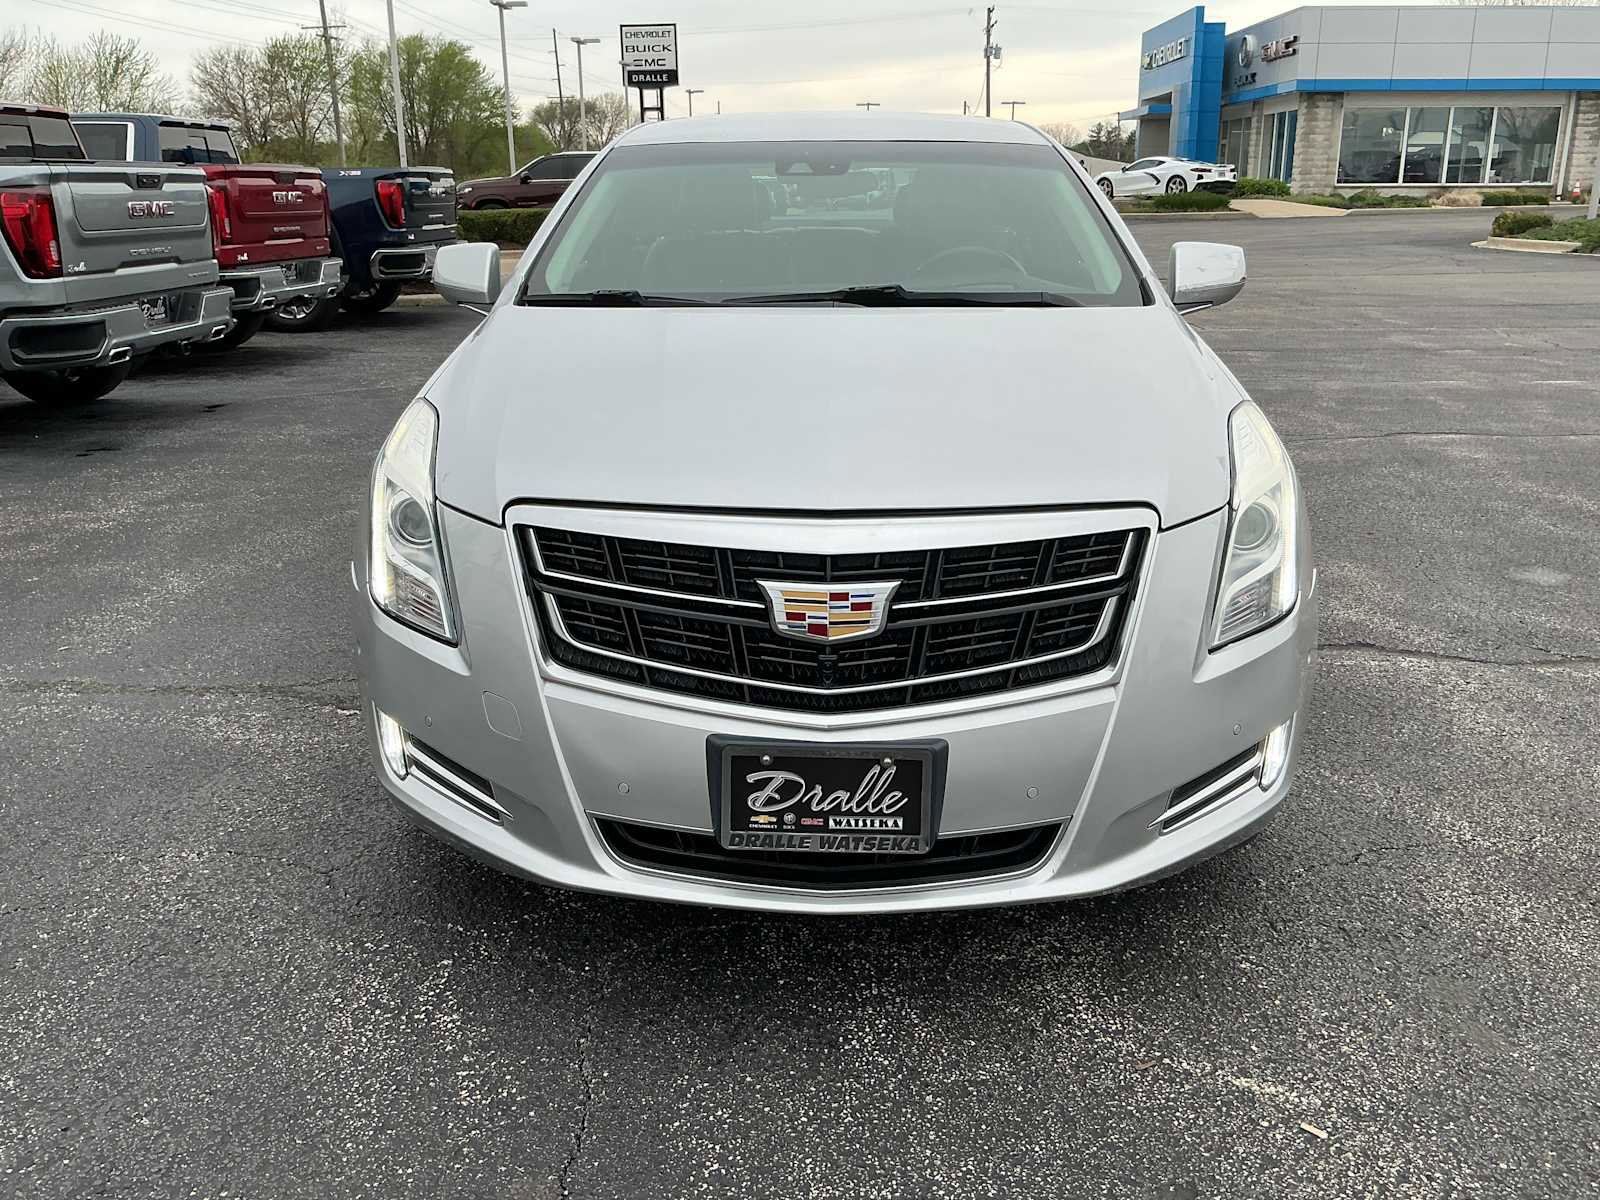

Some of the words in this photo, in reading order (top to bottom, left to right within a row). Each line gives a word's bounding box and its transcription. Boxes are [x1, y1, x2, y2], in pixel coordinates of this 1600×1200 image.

[625, 44, 672, 52] BUICK
[1152, 38, 1186, 68] CHEVROLET
[1261, 35, 1297, 61] GMC
[632, 74, 669, 82] DRALLE
[273, 191, 304, 204] GMC
[128, 201, 175, 219] GMC
[746, 764, 909, 814] Dralle
[831, 818, 902, 829] WATSEKA
[728, 833, 811, 849] DRALLE
[820, 835, 921, 851] WATSEKA
